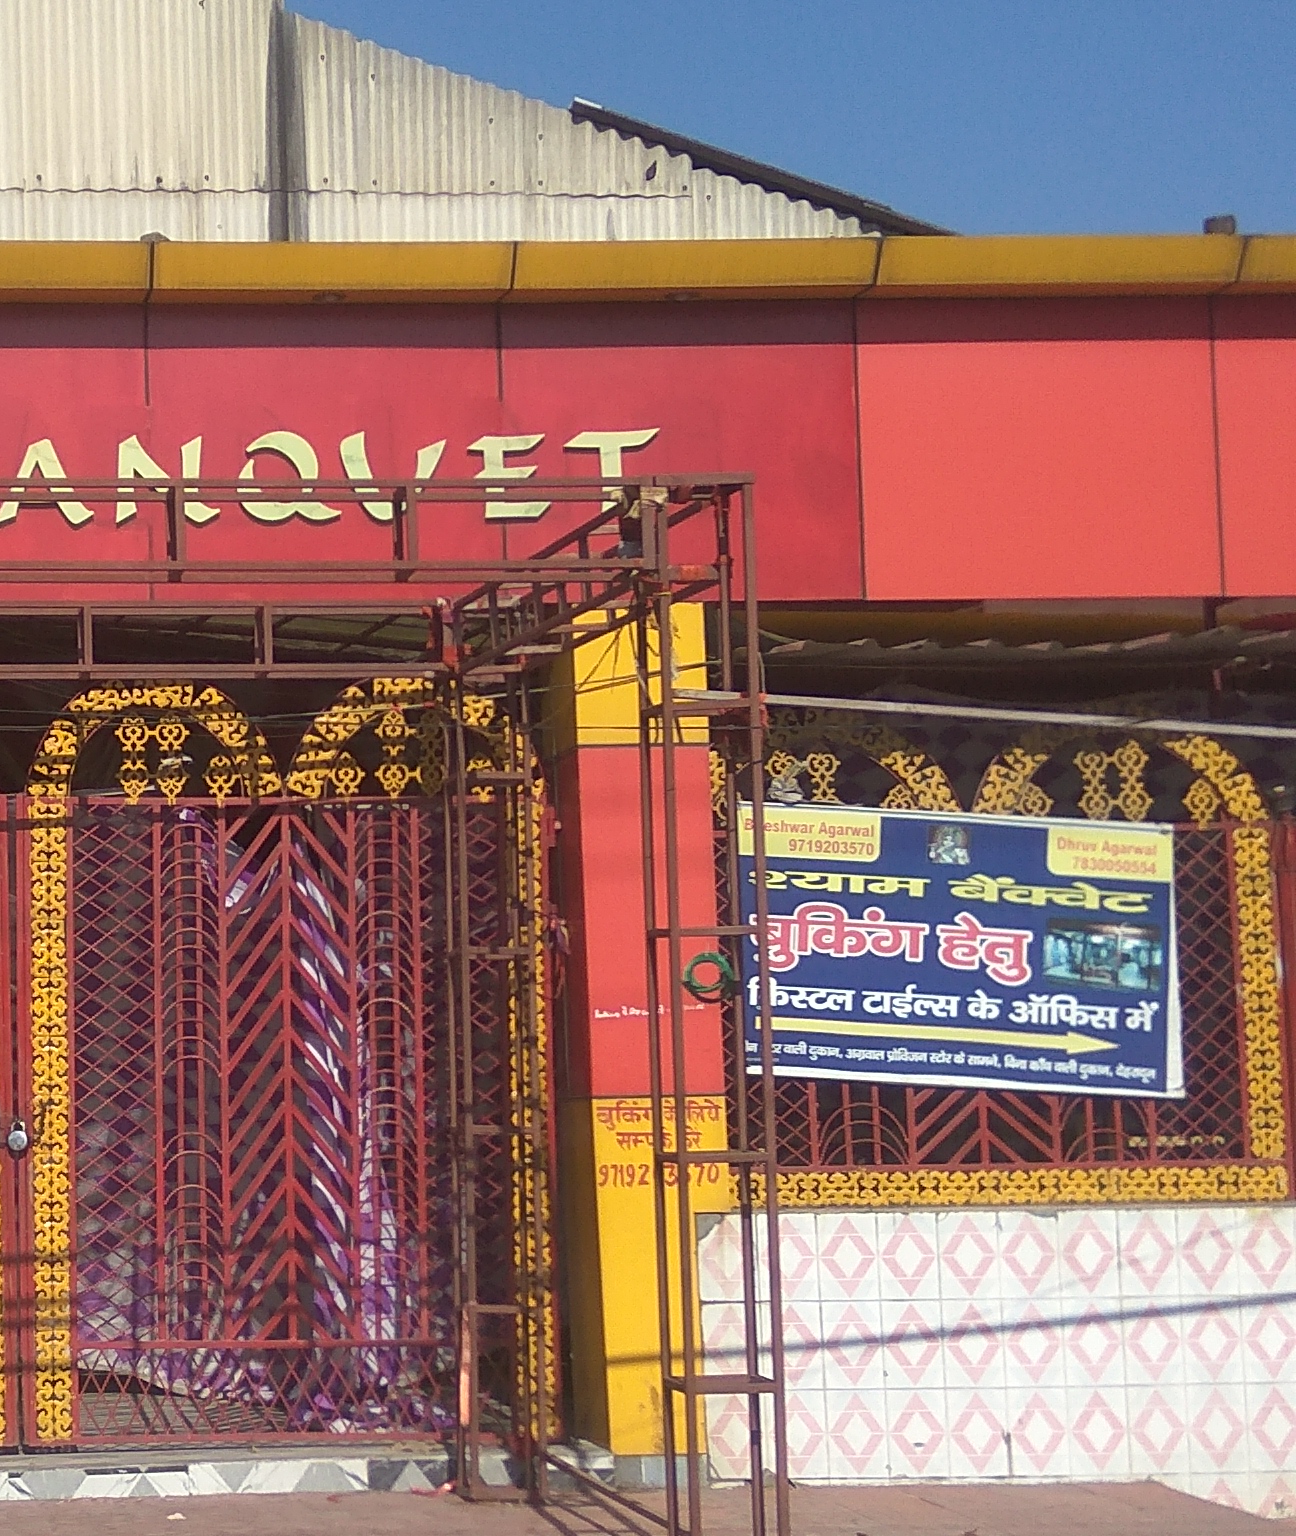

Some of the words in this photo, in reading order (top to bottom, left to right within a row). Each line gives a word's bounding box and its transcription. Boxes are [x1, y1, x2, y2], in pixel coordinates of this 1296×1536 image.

[744, 818, 814, 834] Beshwar
[818, 822, 874, 838] Agarwal
[788, 838, 875, 856] 9719203570
[749, 870, 931, 897] श्याम
[749, 902, 929, 972] बुकिंग
[936, 912, 1033, 986] हेतु
[861, 983, 961, 1019] टाईल्स
[966, 988, 1003, 1020] के
[1008, 993, 1119, 1029] ऑफिस
[1124, 1001, 1159, 1032] में
[783, 1041, 807, 1055] वाली
[953, 1051, 965, 1064] के
[598, 1163, 720, 1187] 97192370
